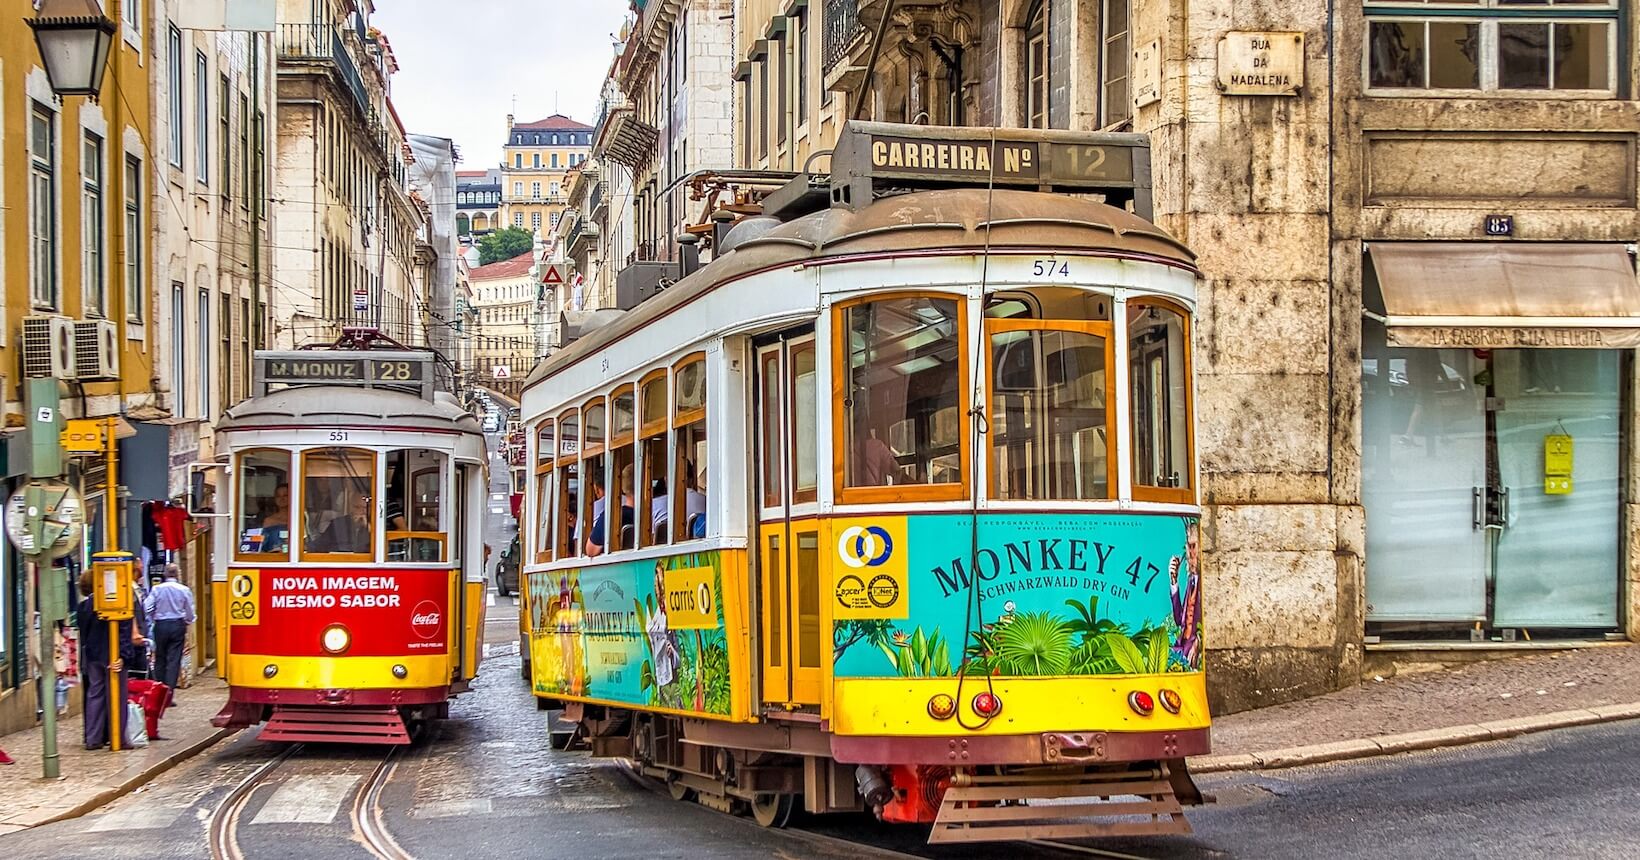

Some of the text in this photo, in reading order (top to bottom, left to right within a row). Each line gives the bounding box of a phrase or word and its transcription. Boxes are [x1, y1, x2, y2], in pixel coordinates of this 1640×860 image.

[1251, 40, 1271, 50] RUA
[1253, 58, 1267, 68] DA
[1231, 75, 1290, 86] MADALENA
[872, 141, 992, 171] CARREIRA
[1066, 146, 1106, 177] 12
[1033, 260, 1069, 277] 574
[381, 361, 411, 381] 28
[329, 432, 349, 442] 551
[931, 538, 1160, 598] MONKEY 47
[272, 576, 399, 591] NOVA IMAGEM,
[979, 576, 1130, 602] SCHWARZWALD DRY GIN
[271, 594, 400, 608] MESMO SABOR
[670, 581, 695, 612] carris
